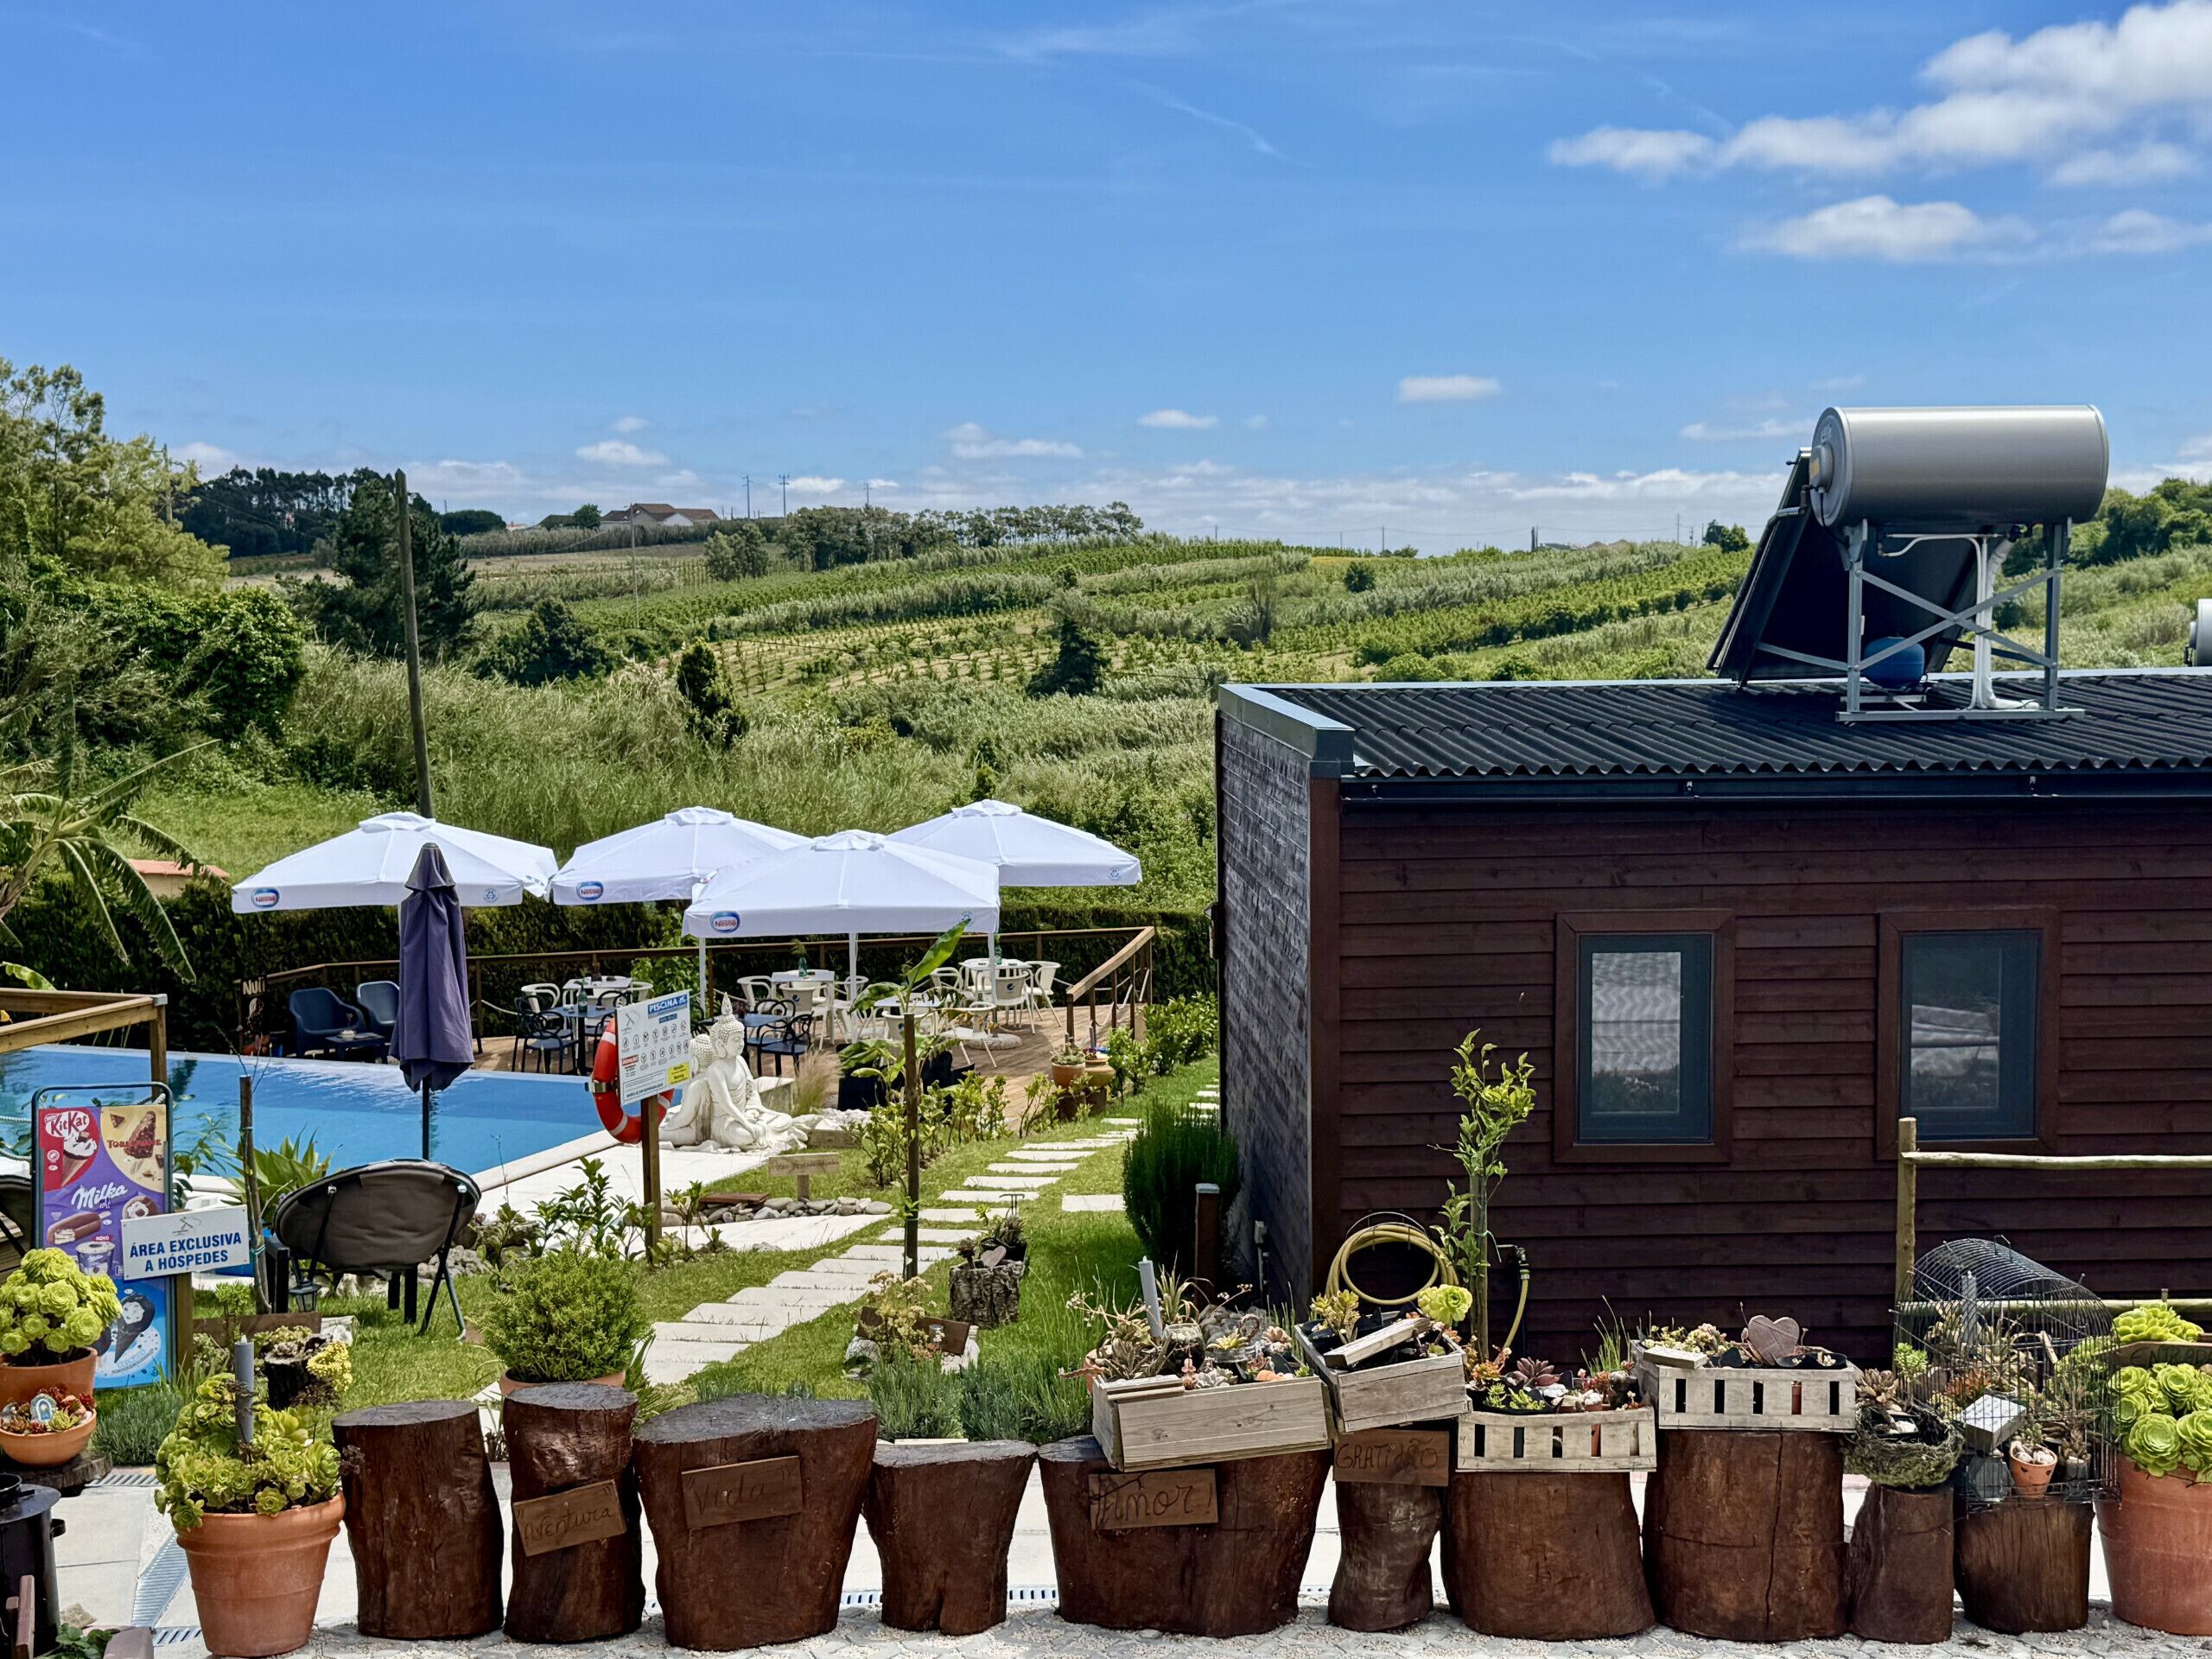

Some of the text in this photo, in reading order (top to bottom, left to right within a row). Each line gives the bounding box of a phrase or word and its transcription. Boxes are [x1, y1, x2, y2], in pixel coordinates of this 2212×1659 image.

[649, 997, 678, 1013] PISCINA
[50, 1111, 87, 1136] KitKat
[71, 1181, 128, 1210] Milka
[130, 1232, 241, 1258] ÁREA EXCLUSIVA
[144, 1249, 228, 1272] A HÓSPEDES
[2130, 1346, 2212, 1365] ENTRAD
